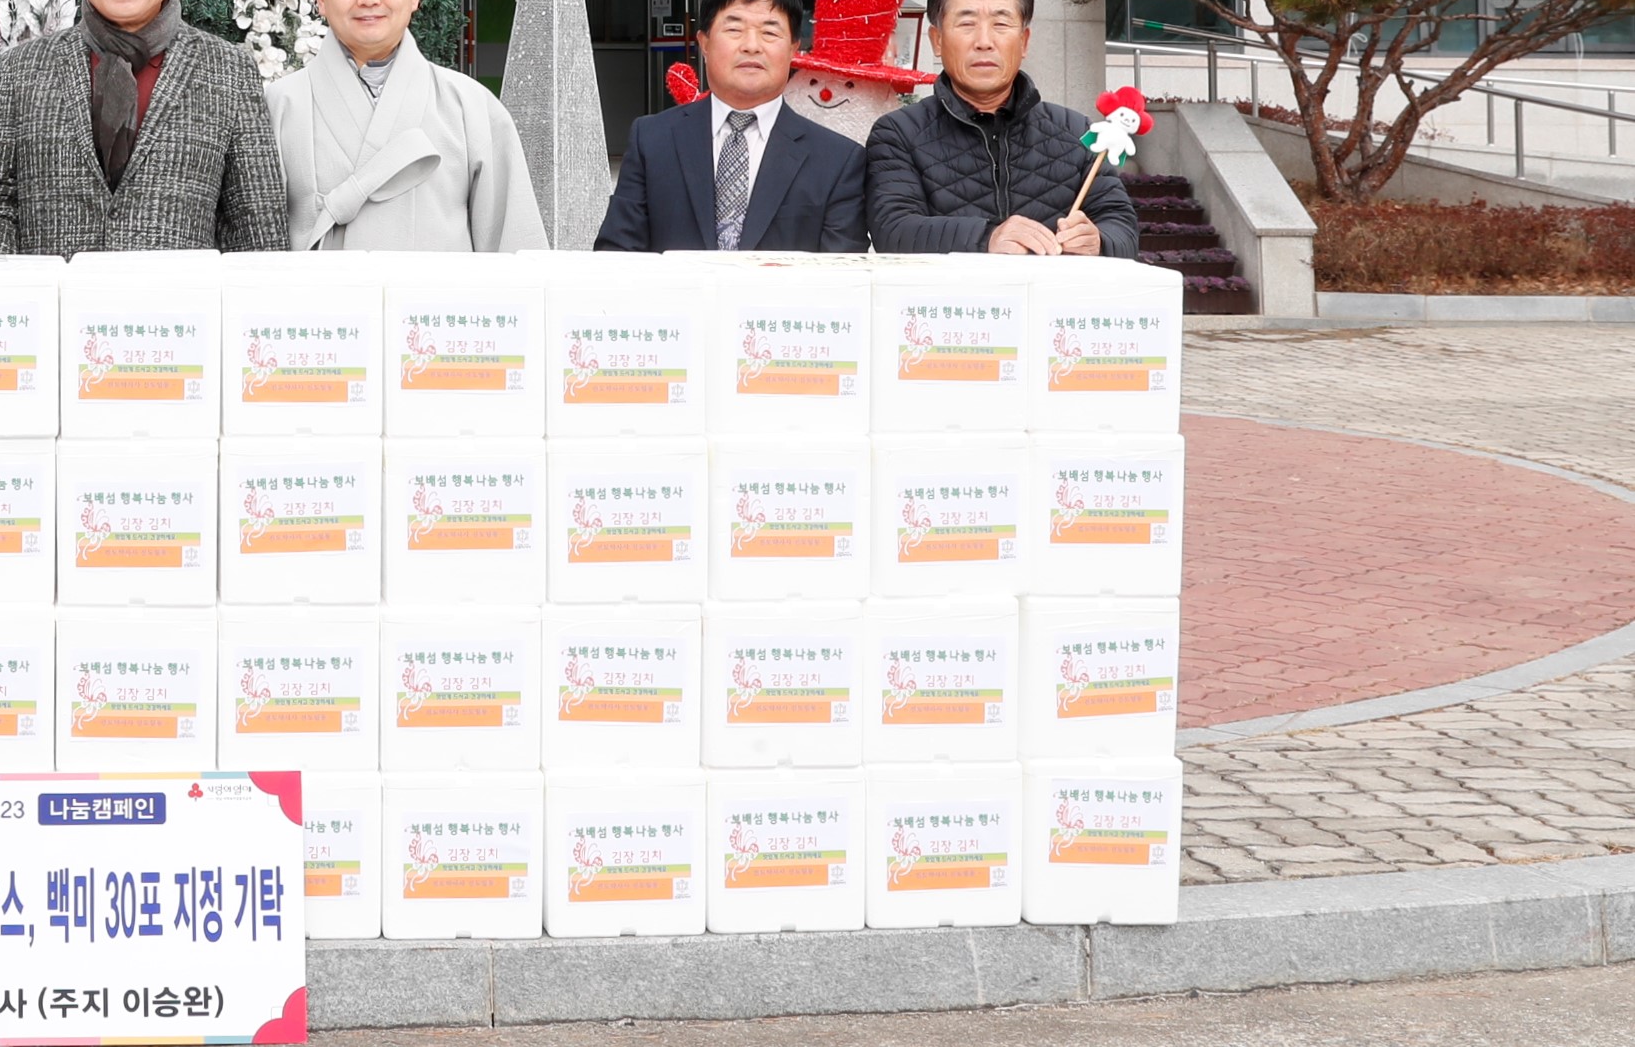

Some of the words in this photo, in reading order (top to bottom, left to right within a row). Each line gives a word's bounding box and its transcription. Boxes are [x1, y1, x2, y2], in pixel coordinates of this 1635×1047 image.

[86, 324, 119, 338] 보배섬
[174, 325, 196, 338] 행사
[1055, 317, 1086, 331] 보배섬
[1139, 317, 1160, 330] 행사
[570, 329, 603, 342] 보배섬
[658, 329, 680, 342] 행사
[1090, 342, 1112, 356] 김장
[1117, 341, 1139, 355] 김치
[123, 350, 145, 364] 김장
[151, 349, 174, 363] 김치
[607, 354, 630, 368] 김장
[635, 353, 658, 367] 김치
[11, 477, 34, 491] 행사
[414, 475, 447, 488] 보배섬
[502, 473, 525, 487] 행사
[904, 487, 935, 502] 보배섬
[987, 485, 1009, 498] 행사
[451, 499, 474, 514] 김장
[479, 498, 503, 513] 김치
[939, 511, 961, 526] 김장
[966, 510, 989, 525] 김치
[242, 658, 275, 671] 보배섬
[330, 656, 353, 670] 행사
[889, 650, 921, 663] 보배섬
[975, 649, 996, 662] 행사
[925, 674, 947, 688] 김장
[952, 673, 975, 688] 김치
[280, 682, 302, 697] 김장
[308, 681, 331, 696] 김치
[50, 797, 155, 820] 나눔캠페인
[731, 812, 763, 827] 보배섬
[817, 810, 839, 824] 행사
[330, 820, 353, 833] 행사
[767, 836, 790, 851] 김장
[795, 835, 818, 850] 김치
[308, 846, 331, 859] 김치
[47, 867, 94, 943] 백미
[105, 871, 163, 938] 30포
[174, 866, 223, 942] 지정
[234, 866, 284, 941] 기탁
[38, 986, 109, 1019] (주지
[123, 985, 225, 1018] 이승완)
